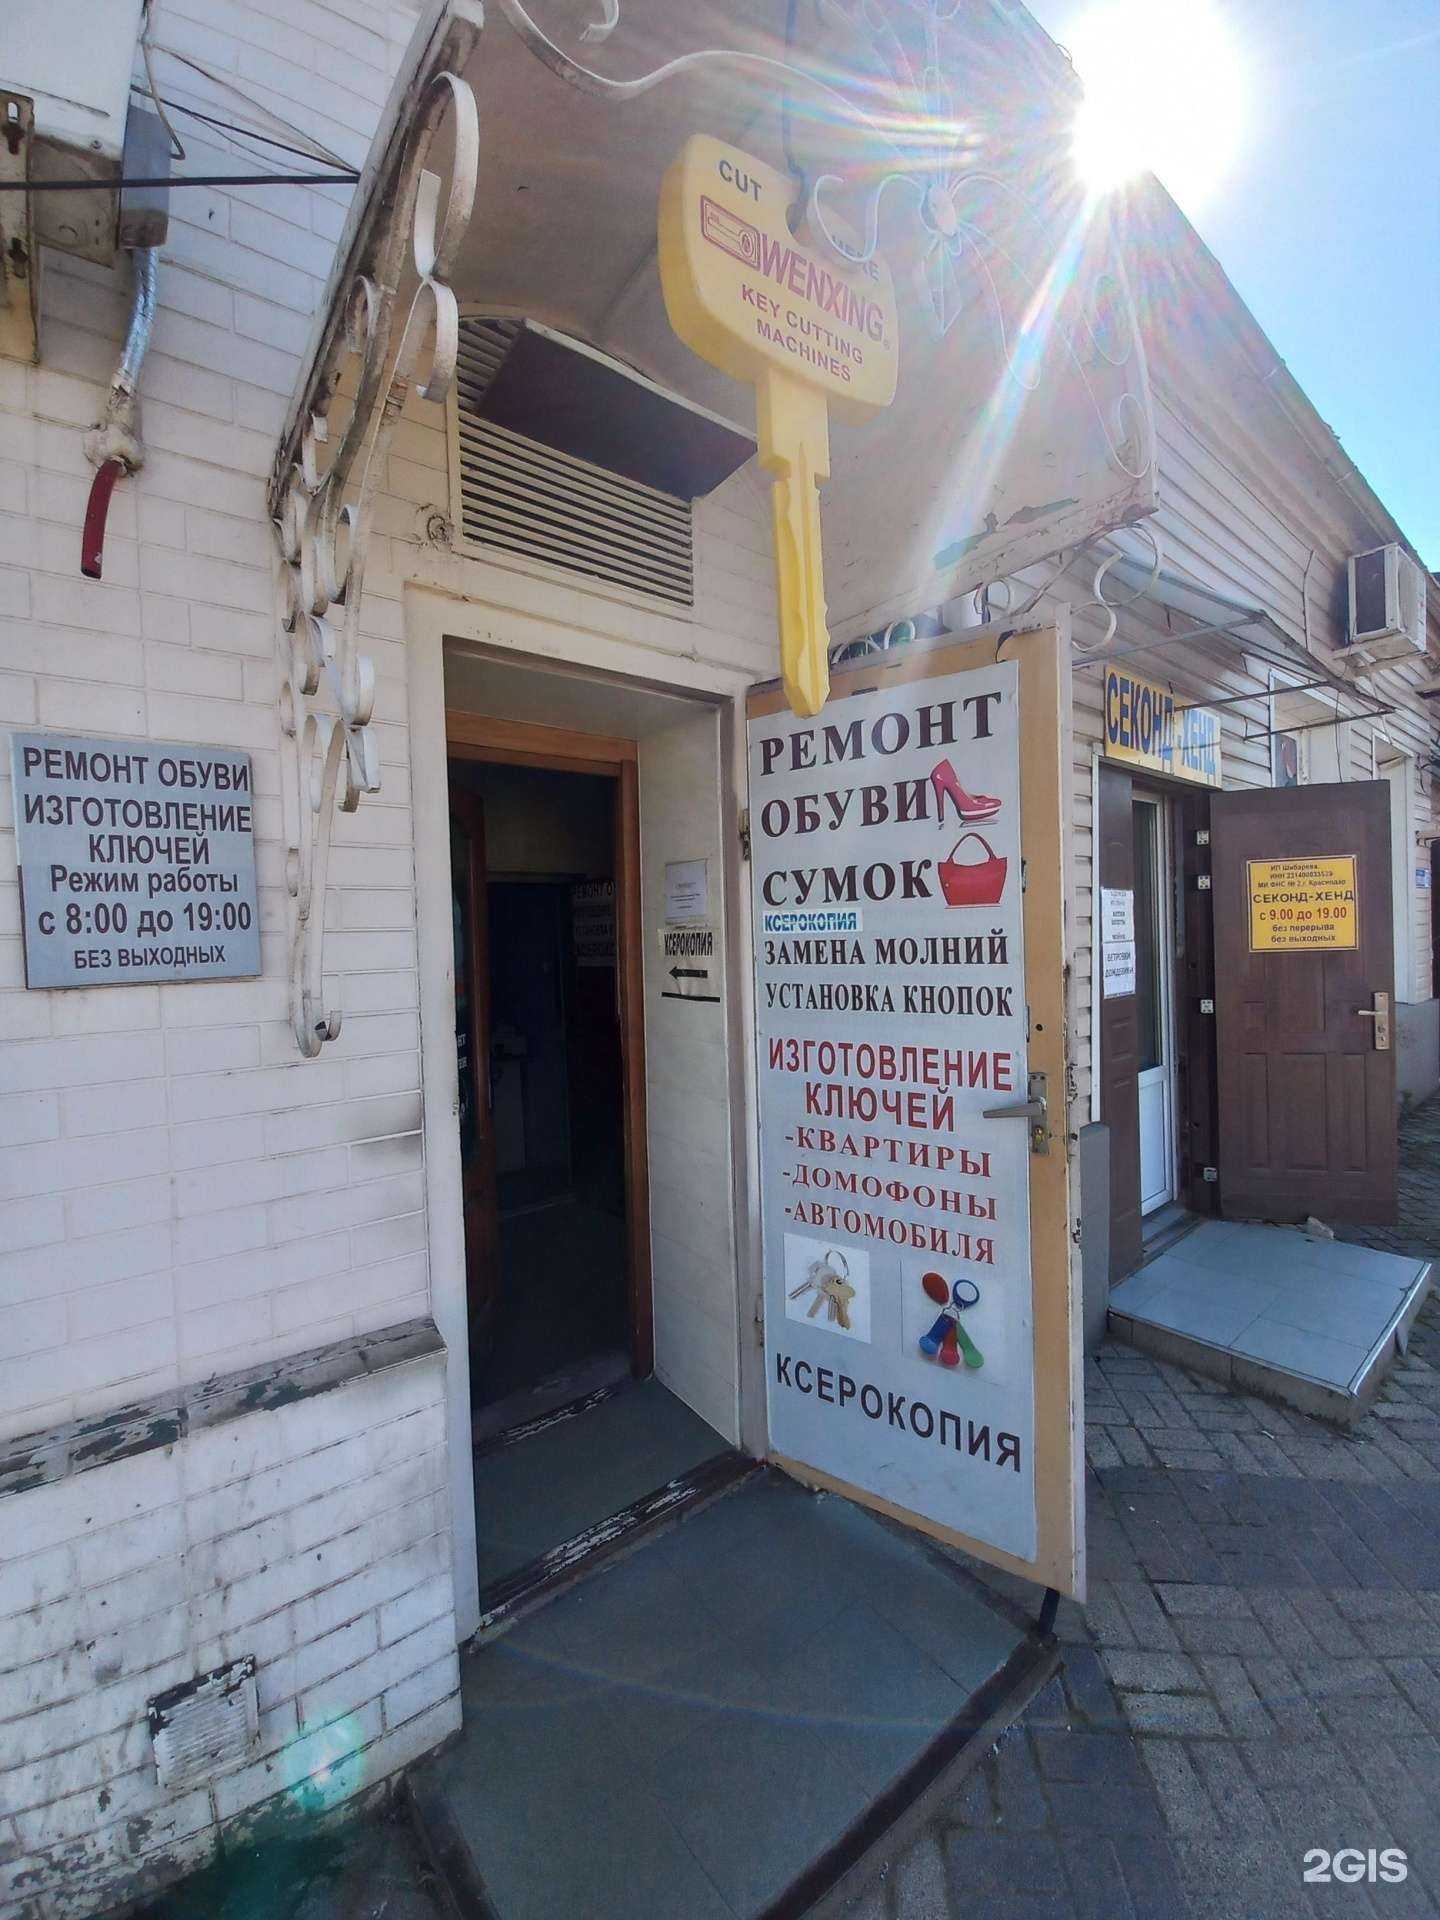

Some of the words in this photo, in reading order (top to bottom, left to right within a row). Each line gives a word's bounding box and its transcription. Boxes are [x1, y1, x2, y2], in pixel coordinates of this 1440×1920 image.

[718, 159, 762, 202] CUT
[761, 232, 885, 343] WENXING
[742, 284, 781, 318] KEY
[785, 310, 864, 365] CUTTING
[756, 318, 852, 383] MACHINES
[760, 691, 1002, 777] РЕМОНТ
[23, 746, 149, 785] РЕМОНТ
[157, 758, 250, 792] ОБУВИ
[23, 793, 252, 833] ИЗГОТОВЛЕНИЕ
[760, 777, 933, 838] ОБУВИ
[88, 832, 210, 865] КЛЮЧЕЙ
[50, 864, 139, 893] Режим
[148, 865, 239, 899] работы
[762, 858, 933, 907] СУМОК
[1253, 890, 1354, 904] СЕКОНД-ХЕНД
[38, 909, 56, 935] с
[66, 903, 128, 935] 8:00
[136, 908, 174, 938] до
[183, 901, 251, 932] 19:00
[763, 911, 857, 932] КСЕРОКОПИЯ
[1269, 908, 1293, 920] 9.00
[1296, 911, 1312, 921] до
[1316, 906, 1347, 919] 19.00
[74, 949, 112, 970] БЕЗ
[118, 944, 227, 967] ВЫХОДНЫХ
[664, 931, 713, 957] КСЕРОКОПИЯ
[763, 939, 866, 966] ЗАМЕНА
[875, 928, 1009, 966] МОЛНИЙ
[766, 983, 896, 1014] УСТАНОВКА
[903, 984, 1014, 1017] КНОПОК
[768, 1037, 1013, 1092] ИЗГОТОВЛЕНИЕ
[805, 1081, 955, 1133] КЛЮЧЕЙ
[784, 1126, 992, 1178] -КВАРТИРЫ
[782, 1163, 998, 1221] -ДОМОФОНЫ
[784, 1200, 996, 1265] -АВТОМОБИЛЯ
[775, 1352, 1022, 1473] КСЕРОКОПИЯ
